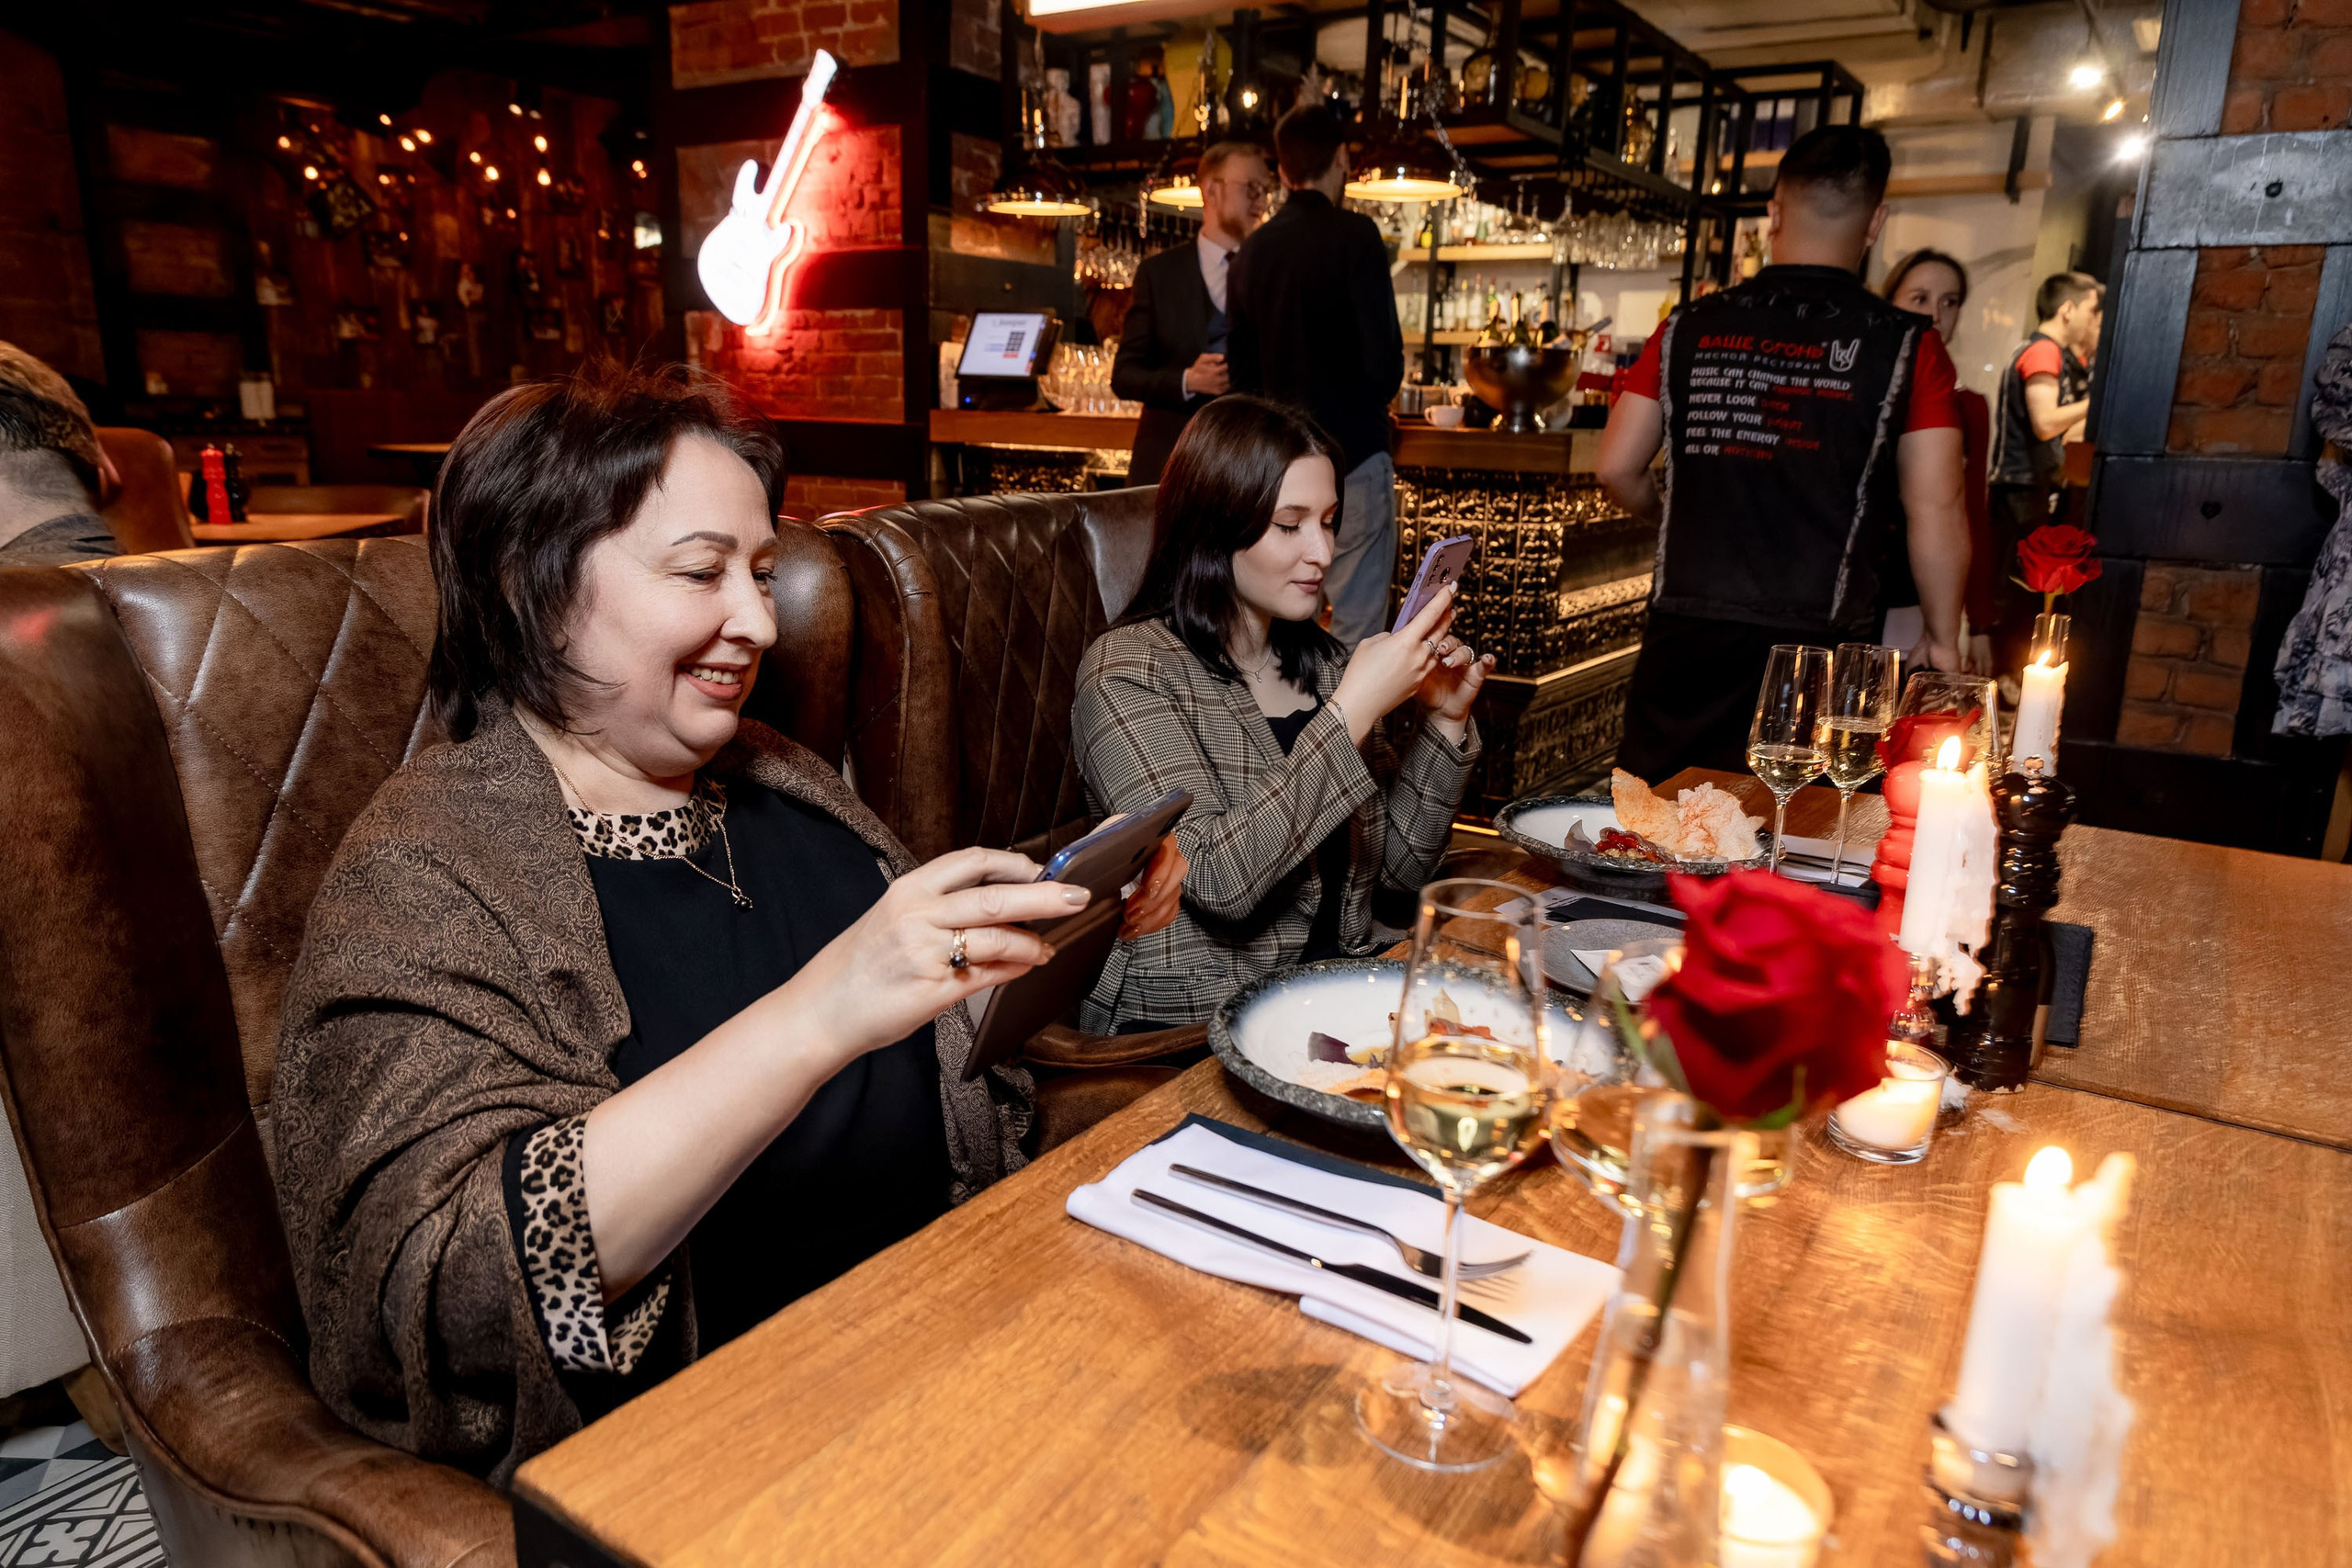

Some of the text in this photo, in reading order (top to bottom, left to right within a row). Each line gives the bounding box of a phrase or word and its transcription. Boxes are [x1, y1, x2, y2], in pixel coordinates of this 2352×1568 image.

[1698, 334, 1824, 359] ВАШЕ ОГОНЬ
[1690, 367, 1850, 390] MUSIC CAN CHANGE THE WORLD
[1690, 378, 1731, 388] BECAUSE
[1735, 378, 1746, 389] IT
[1748, 379, 1769, 392] CAN
[1689, 393, 1722, 404] NEVER
[1725, 394, 1757, 407] LOOK
[1687, 410, 1728, 422] FOLLOW
[1732, 412, 1763, 427] YOUR
[1685, 426, 1706, 439] FEEL
[1711, 427, 1732, 439] THE
[1736, 430, 1780, 446] ENERGY
[1685, 444, 1700, 455] ALL
[1702, 445, 1720, 457] OR
